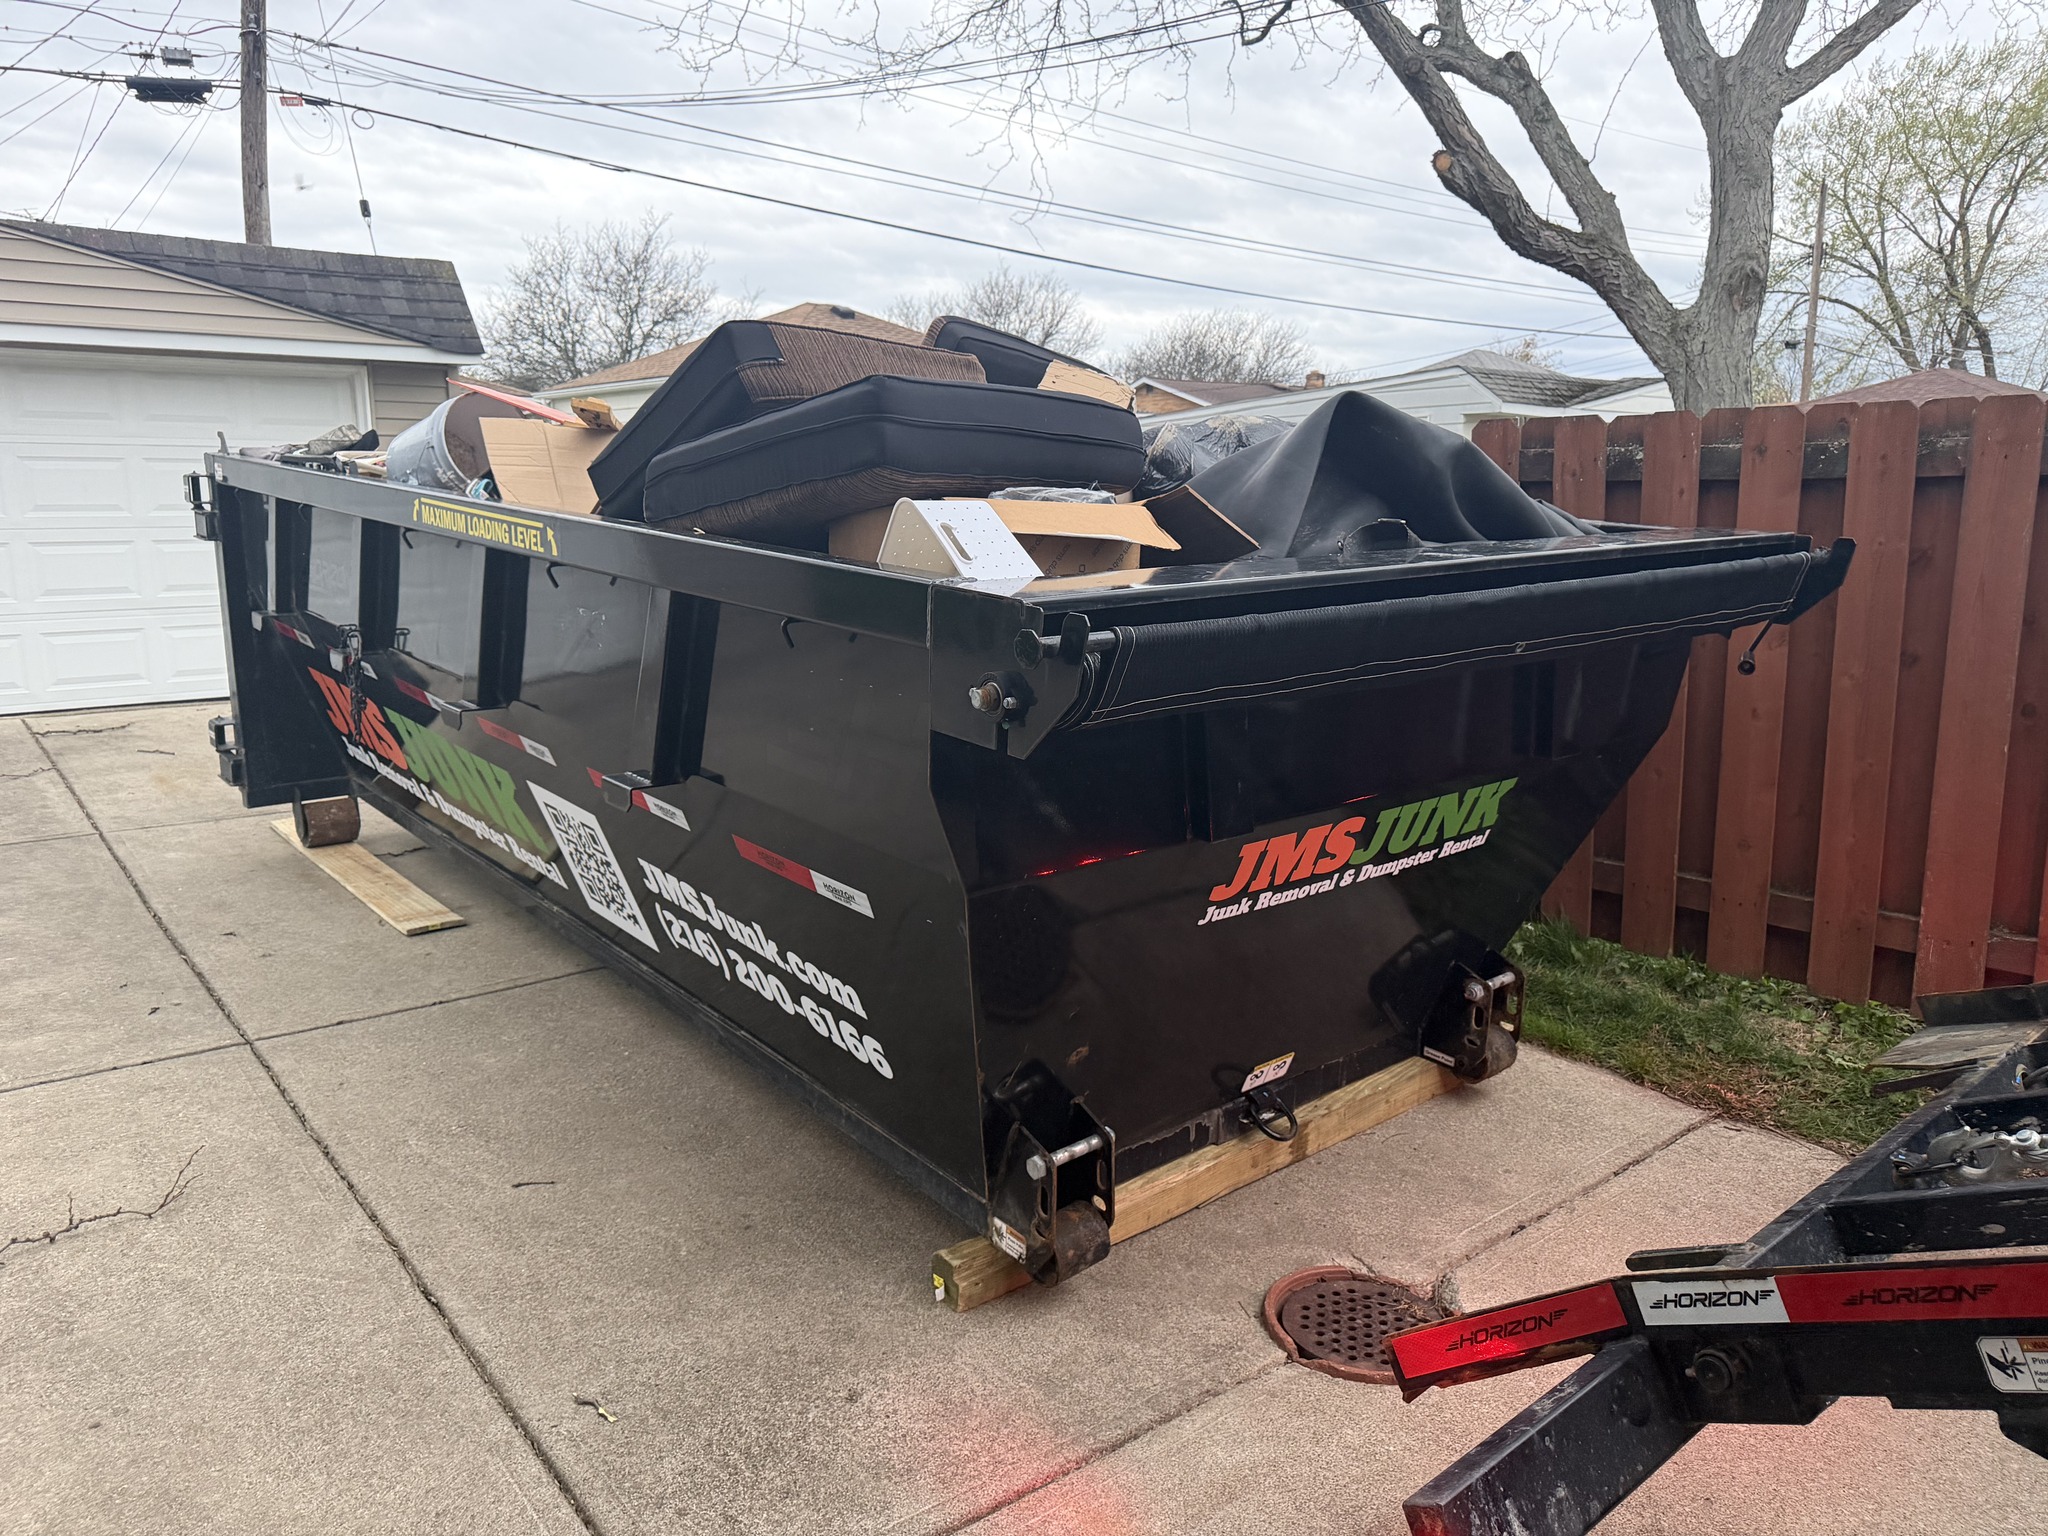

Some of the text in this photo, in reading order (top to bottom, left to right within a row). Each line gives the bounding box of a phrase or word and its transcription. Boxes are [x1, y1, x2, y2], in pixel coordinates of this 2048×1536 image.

[421, 504, 544, 553] MAXIMUM LOADING LEVEL
[341, 735, 569, 890] Junk Removal & Dumpster Rental
[1197, 829, 1491, 926] Junk Removal & Dumpster Rental
[637, 857, 868, 1020] JMSJunk.com
[655, 902, 894, 1080] (216) 200-6166
[1459, 1312, 1553, 1348] HORIZON
[1663, 1290, 1759, 1309] HORIZON
[1859, 1284, 1978, 1305] HORIZON
